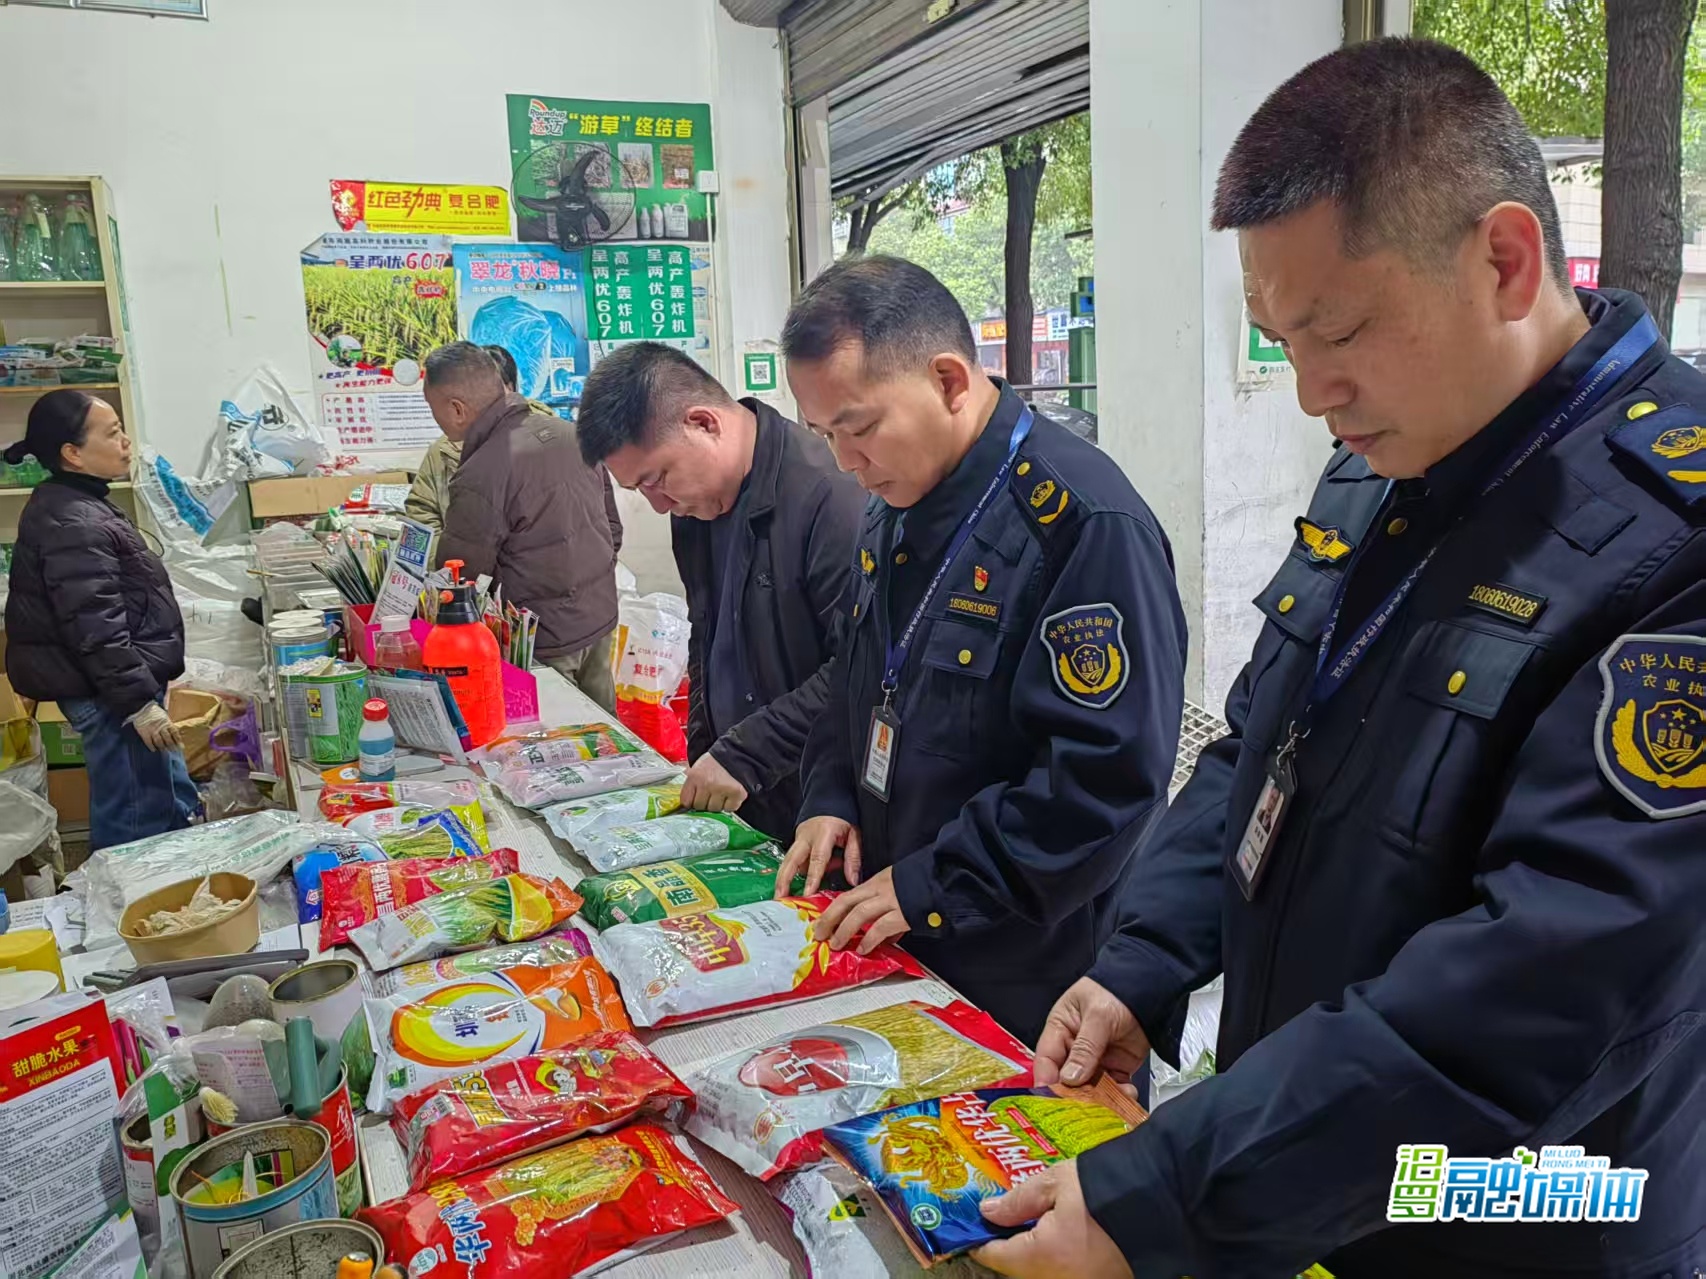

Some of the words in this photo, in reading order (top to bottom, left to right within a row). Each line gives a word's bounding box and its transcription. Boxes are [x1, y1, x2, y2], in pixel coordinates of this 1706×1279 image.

[368, 187, 441, 218] 红色劲典
[350, 252, 447, 270] 呈两优607
[591, 249, 613, 337] 呈两优607
[614, 251, 635, 334] 高产轰炸机
[647, 248, 666, 336] 呈两优607
[668, 250, 687, 333] 高产轰炸机
[949, 597, 998, 617] 18060619006
[1468, 584, 1538, 617] 18060619028
[1049, 616, 1114, 640] 中华人民共和国
[1063, 628, 1105, 645] 农业执法
[12, 1039, 80, 1078] 甜脆水果
[28, 1059, 81, 1087] XINBAODA
